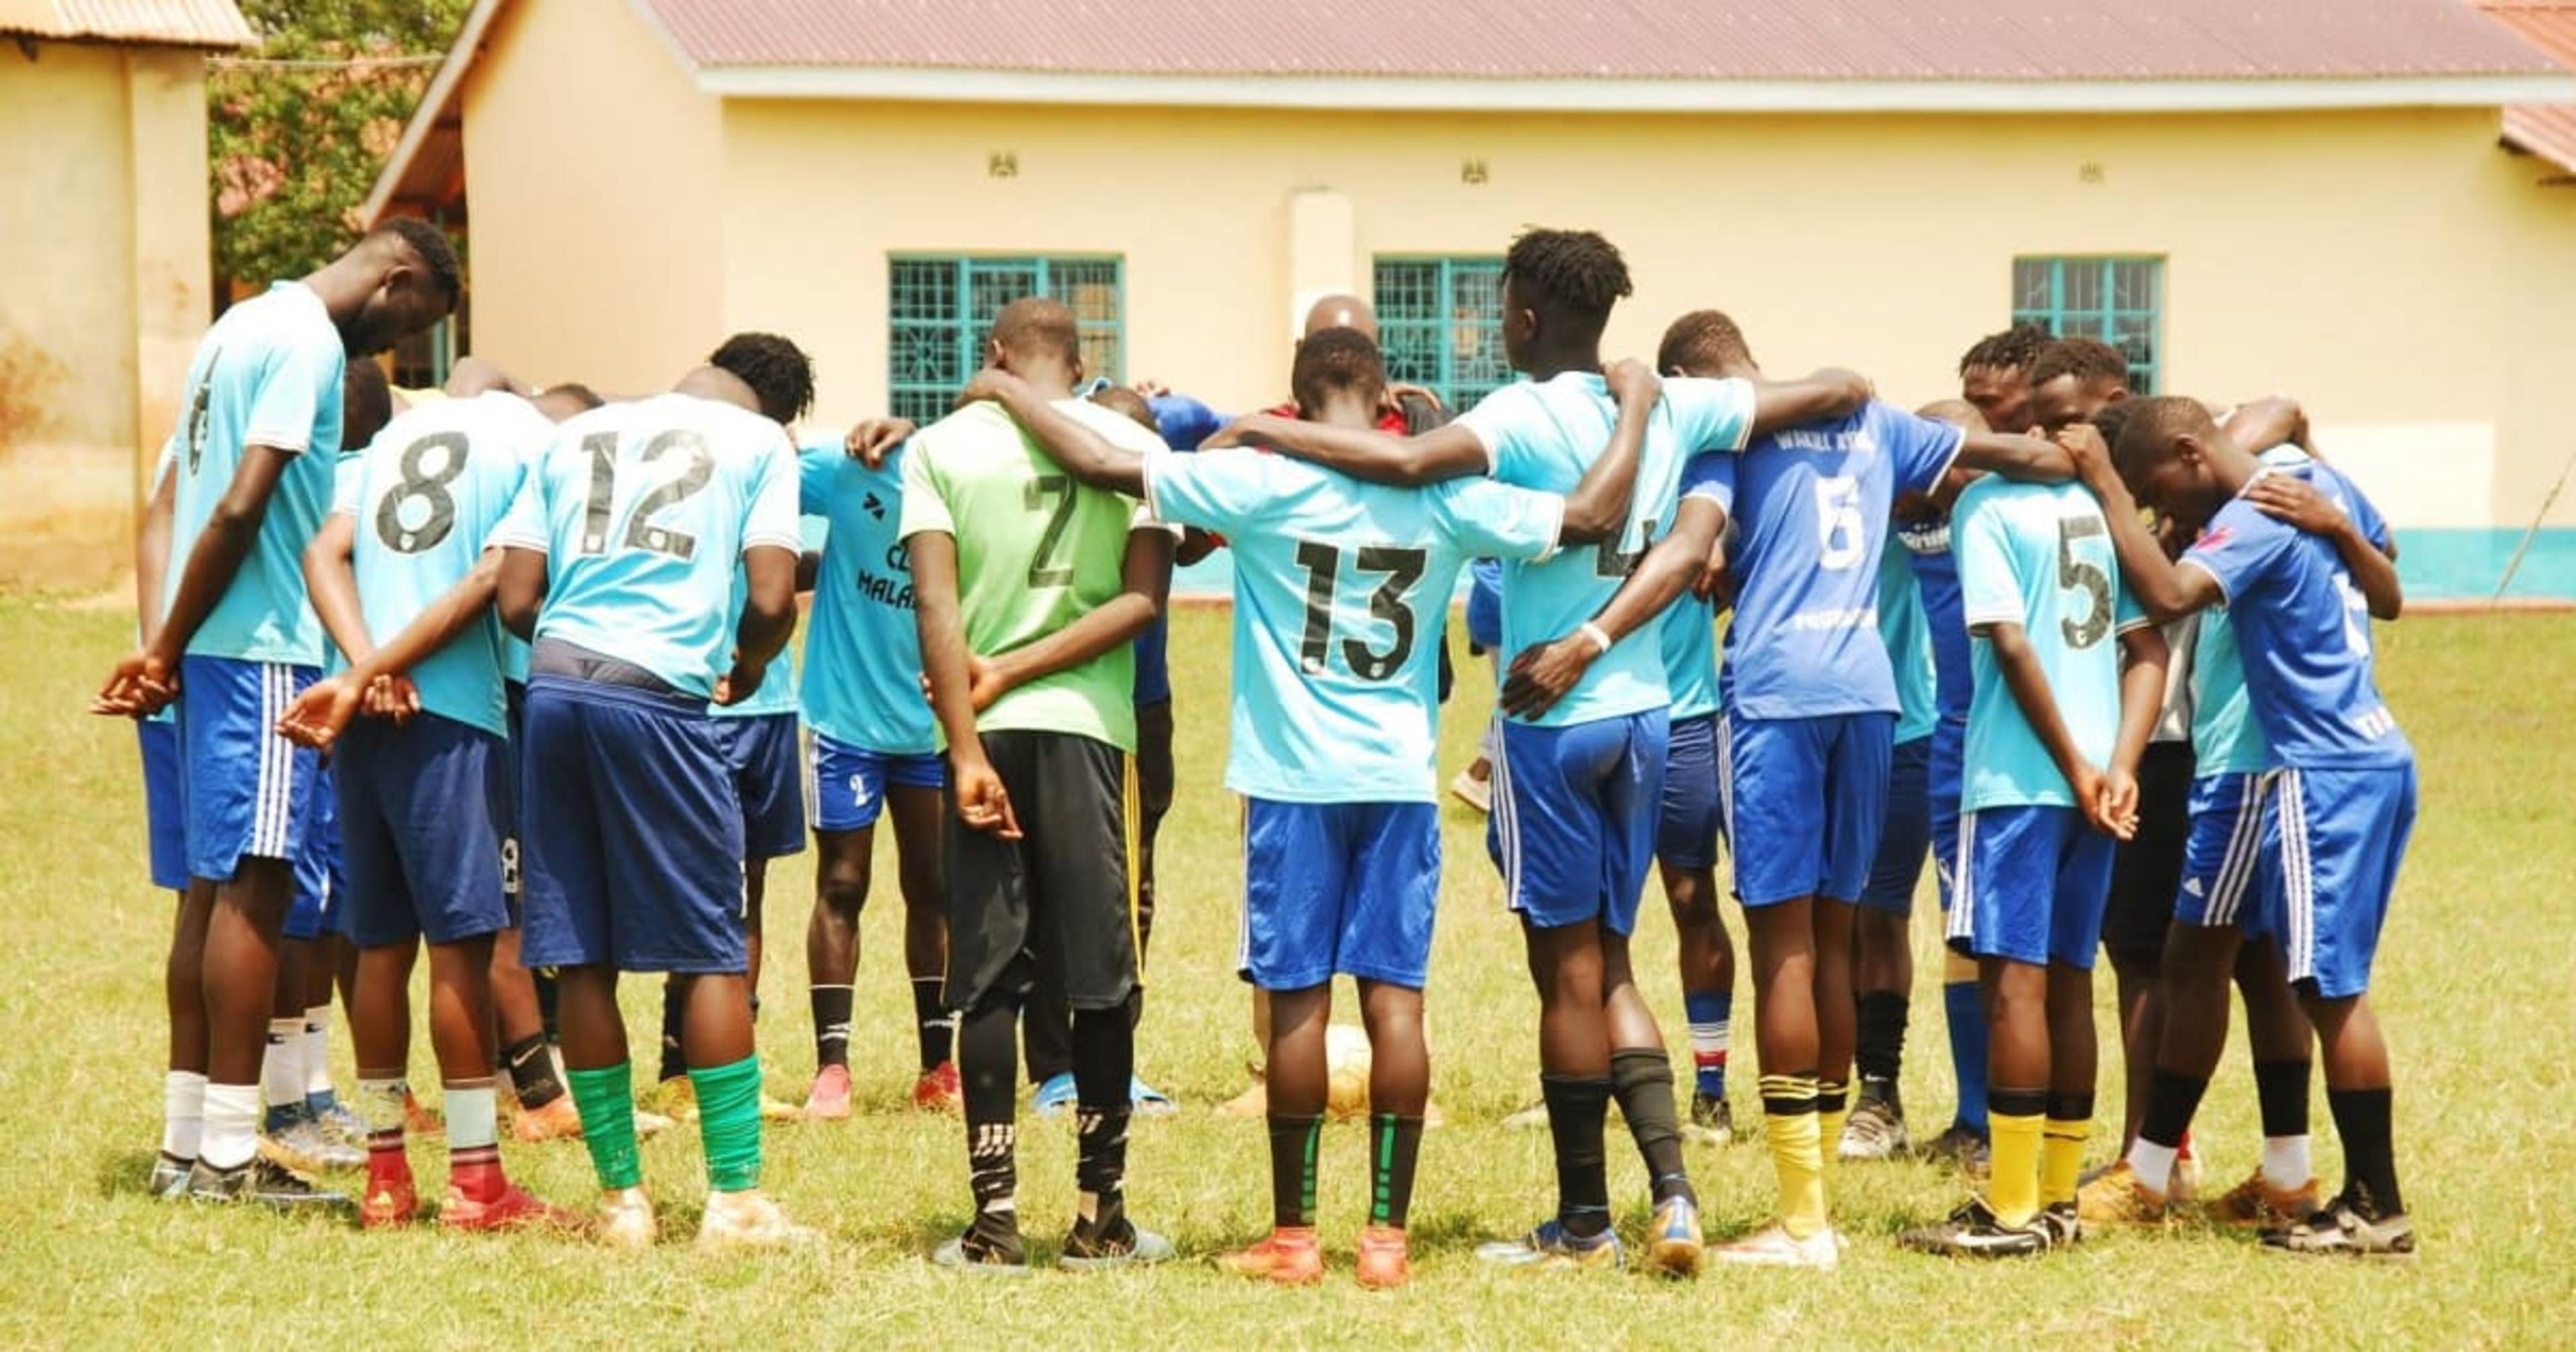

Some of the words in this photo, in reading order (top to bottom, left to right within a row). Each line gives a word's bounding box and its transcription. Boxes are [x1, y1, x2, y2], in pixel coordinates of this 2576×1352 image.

[376, 431, 470, 554] 8
[581, 429, 716, 560] 12
[1024, 475, 1077, 589] 2
[1815, 476, 1864, 570] 6
[857, 568, 917, 610] MALA
[886, 545, 910, 571] CL
[1296, 542, 1427, 681] 13
[2059, 515, 2111, 649] 5
[849, 774, 873, 807] 2
